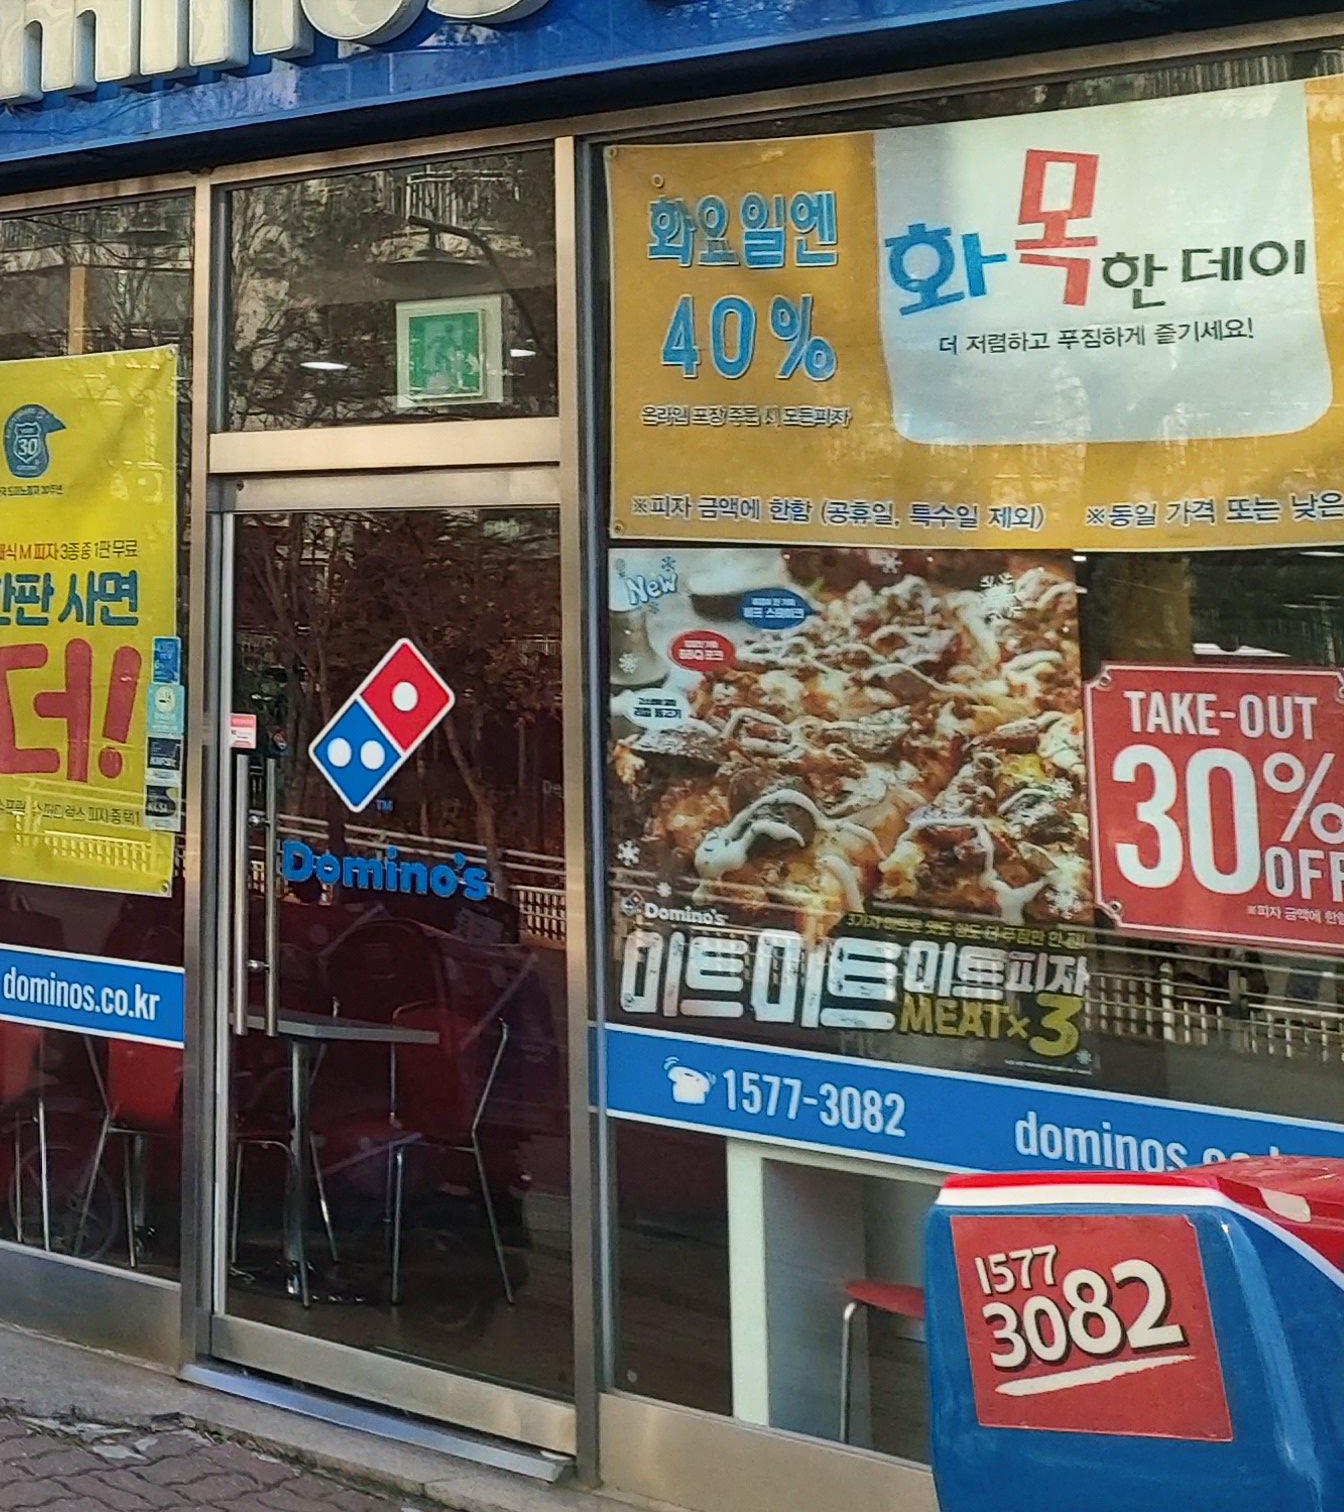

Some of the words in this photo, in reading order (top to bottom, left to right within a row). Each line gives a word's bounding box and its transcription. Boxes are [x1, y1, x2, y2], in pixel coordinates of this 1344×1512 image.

[647, 190, 839, 269] 화요일엔
[1180, 238, 1307, 285] 데이
[939, 333, 961, 355] 더
[965, 329, 1050, 356] 저렴하고
[1057, 324, 1147, 350] 푸짐하게
[1153, 317, 1255, 346] 즐기세요!
[640, 406, 689, 426] 온라인
[691, 406, 727, 427] 포장
[728, 406, 760, 427] 주문
[18, 438, 38, 456] 30
[697, 496, 760, 522] 금액에
[769, 497, 812, 523] 한함
[909, 500, 980, 530] 특수일
[987, 502, 1046, 531] 제외)
[1167, 498, 1216, 525] 가격
[1226, 494, 1281, 522] 또는
[19, 544, 31, 559] M
[33, 543, 59, 561] 피자
[113, 539, 139, 558] 무료
[57, 569, 139, 627] 사면
[625, 571, 678, 606] New
[1122, 690, 1319, 742] TAKE-OUT
[282, 838, 491, 902] Domino's
[644, 901, 728, 926] Domino's
[2, 966, 161, 1022] dominos.co.kr
[722, 1067, 907, 1137] 1577-3082
[974, 1244, 1059, 1296] 1577
[981, 1258, 1186, 1371] 3082
